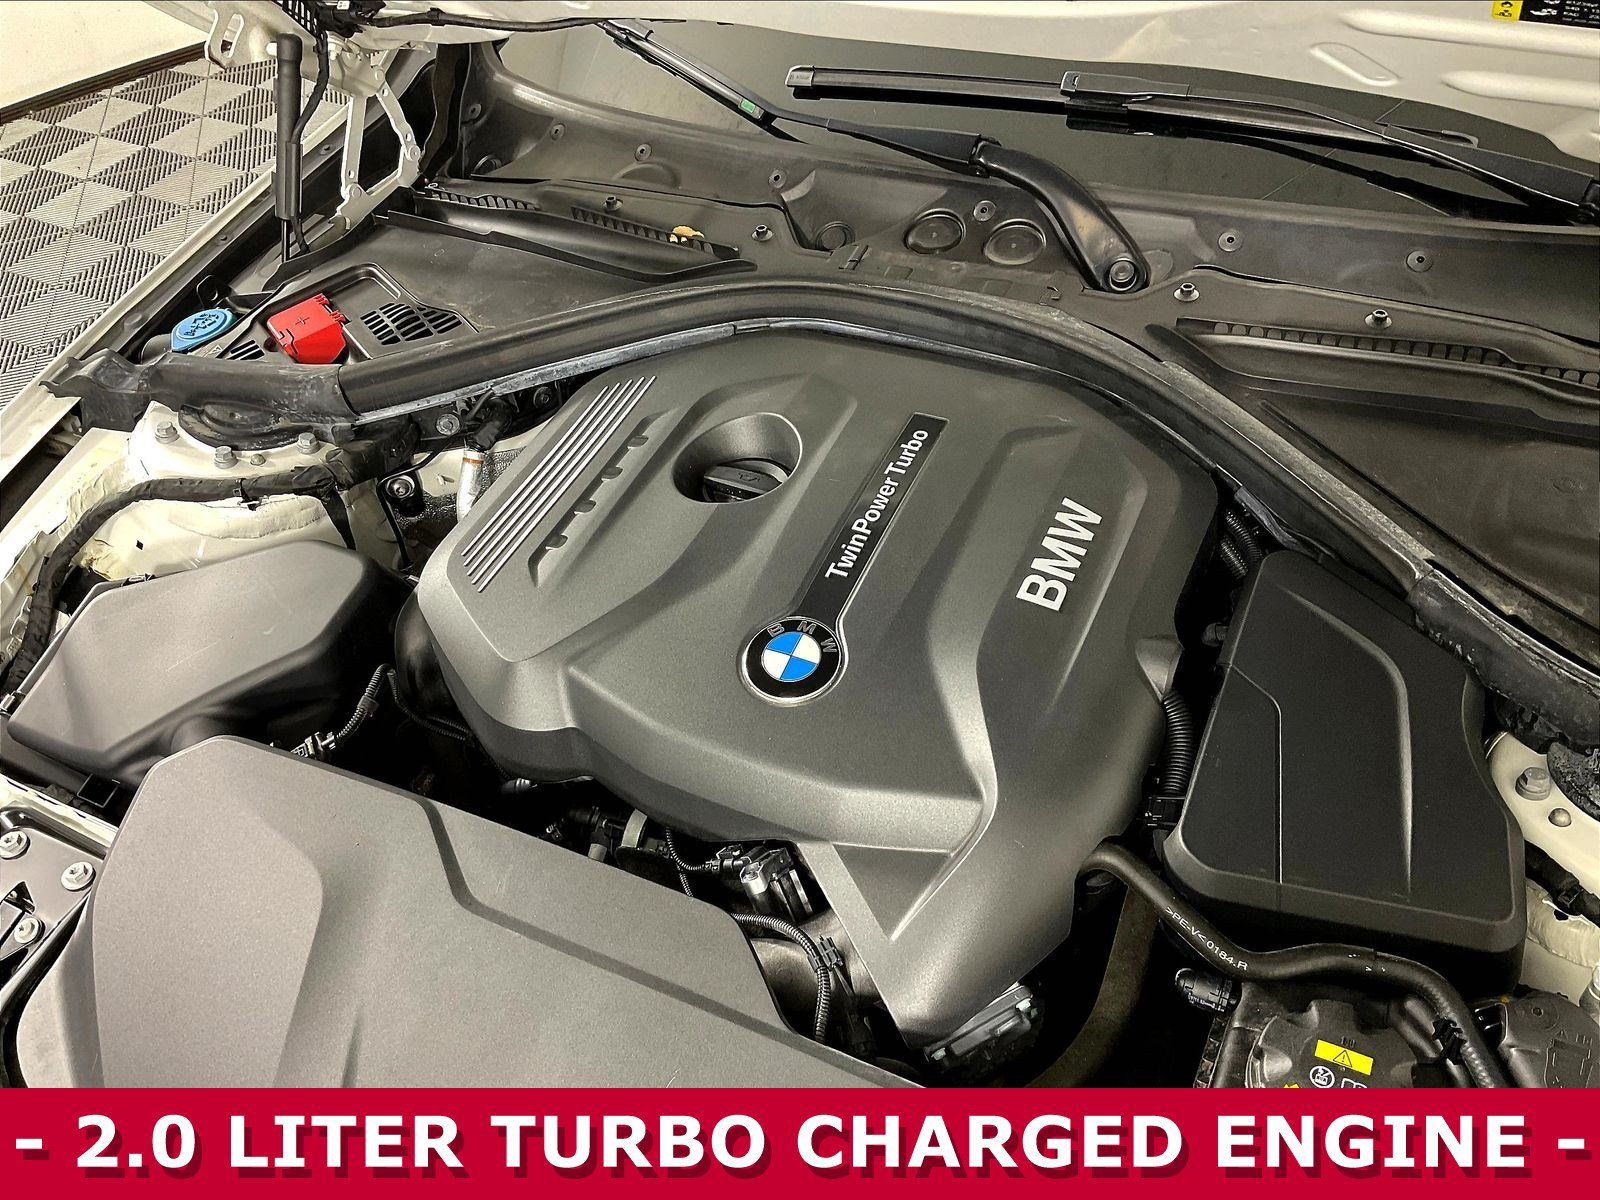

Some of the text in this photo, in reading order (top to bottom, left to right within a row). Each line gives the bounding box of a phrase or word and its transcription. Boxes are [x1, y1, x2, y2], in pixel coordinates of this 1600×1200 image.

[825, 429, 929, 579] TwinPower Turbo
[1016, 497, 1102, 612] BMW
[767, 620, 838, 653] BMW
